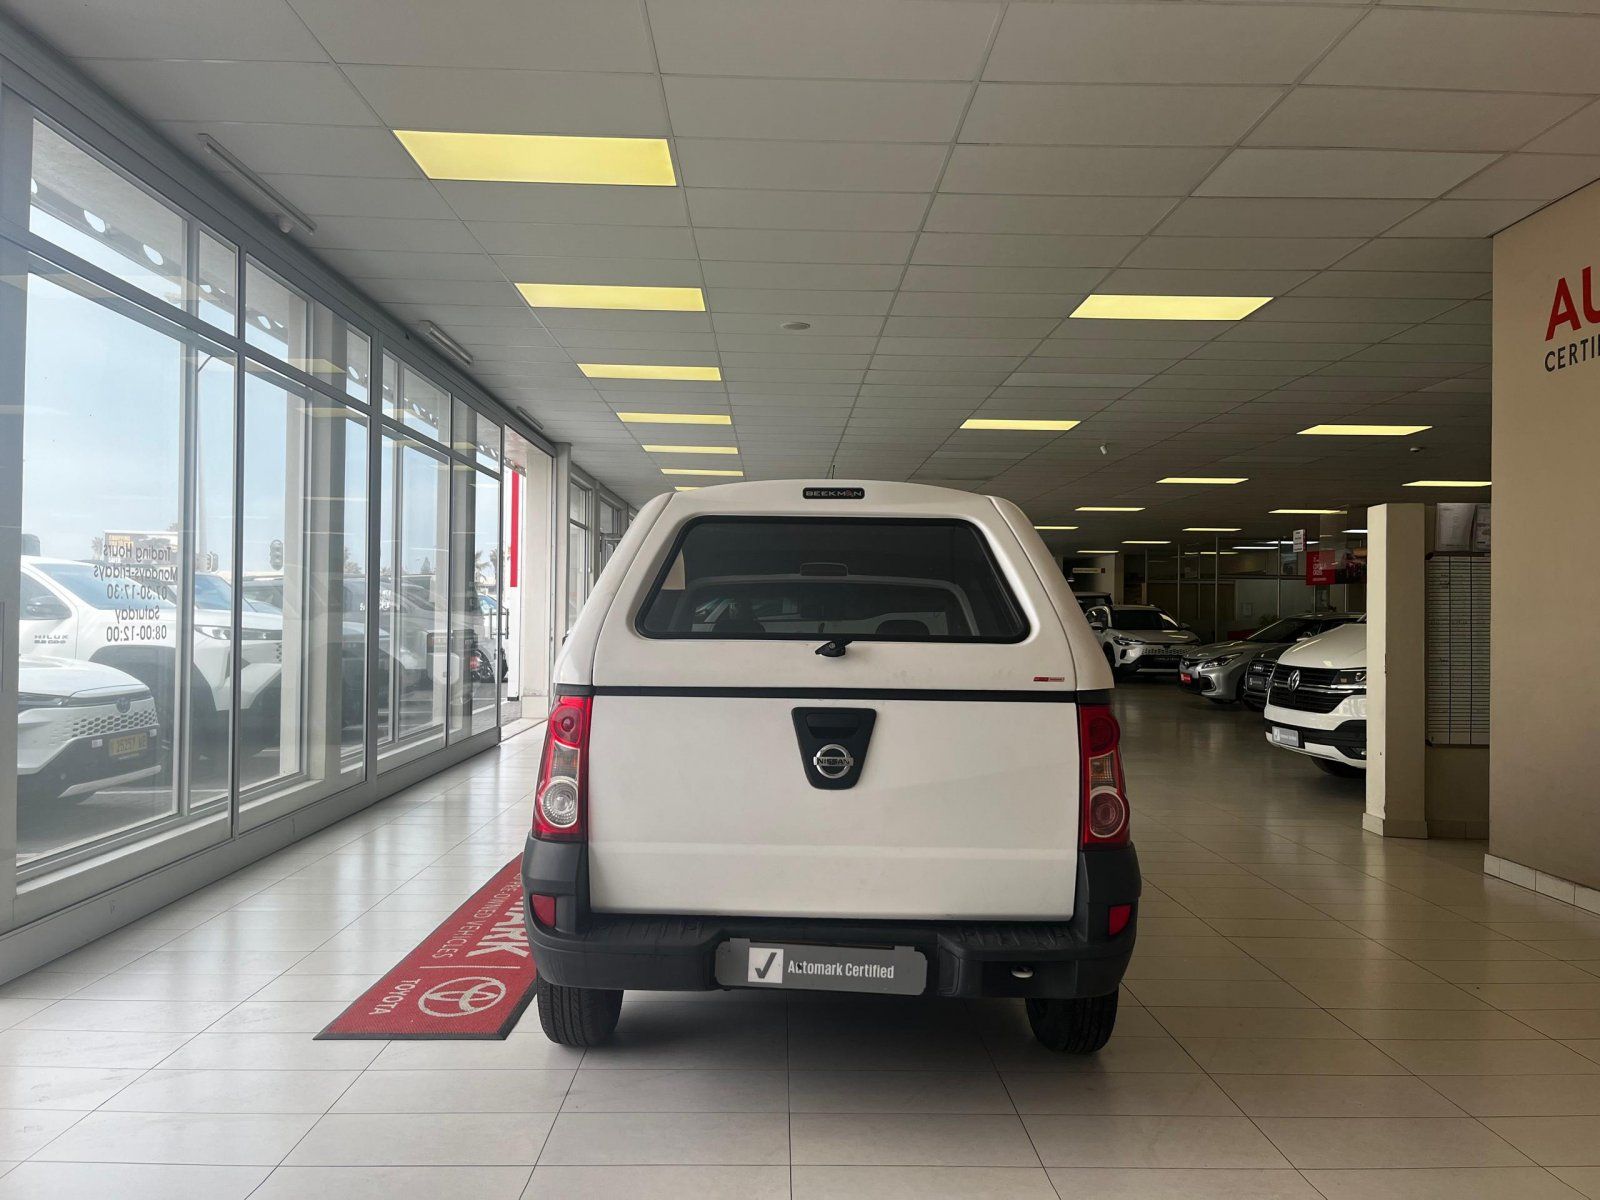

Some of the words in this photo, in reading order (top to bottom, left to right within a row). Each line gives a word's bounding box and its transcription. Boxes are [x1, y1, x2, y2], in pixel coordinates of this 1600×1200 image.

[1545, 334, 1600, 372] CERTI
[432, 920, 487, 958] VEHICLES
[788, 960, 842, 976] Automark
[845, 964, 894, 979] Certified
[369, 978, 422, 1015] TOYOTA
